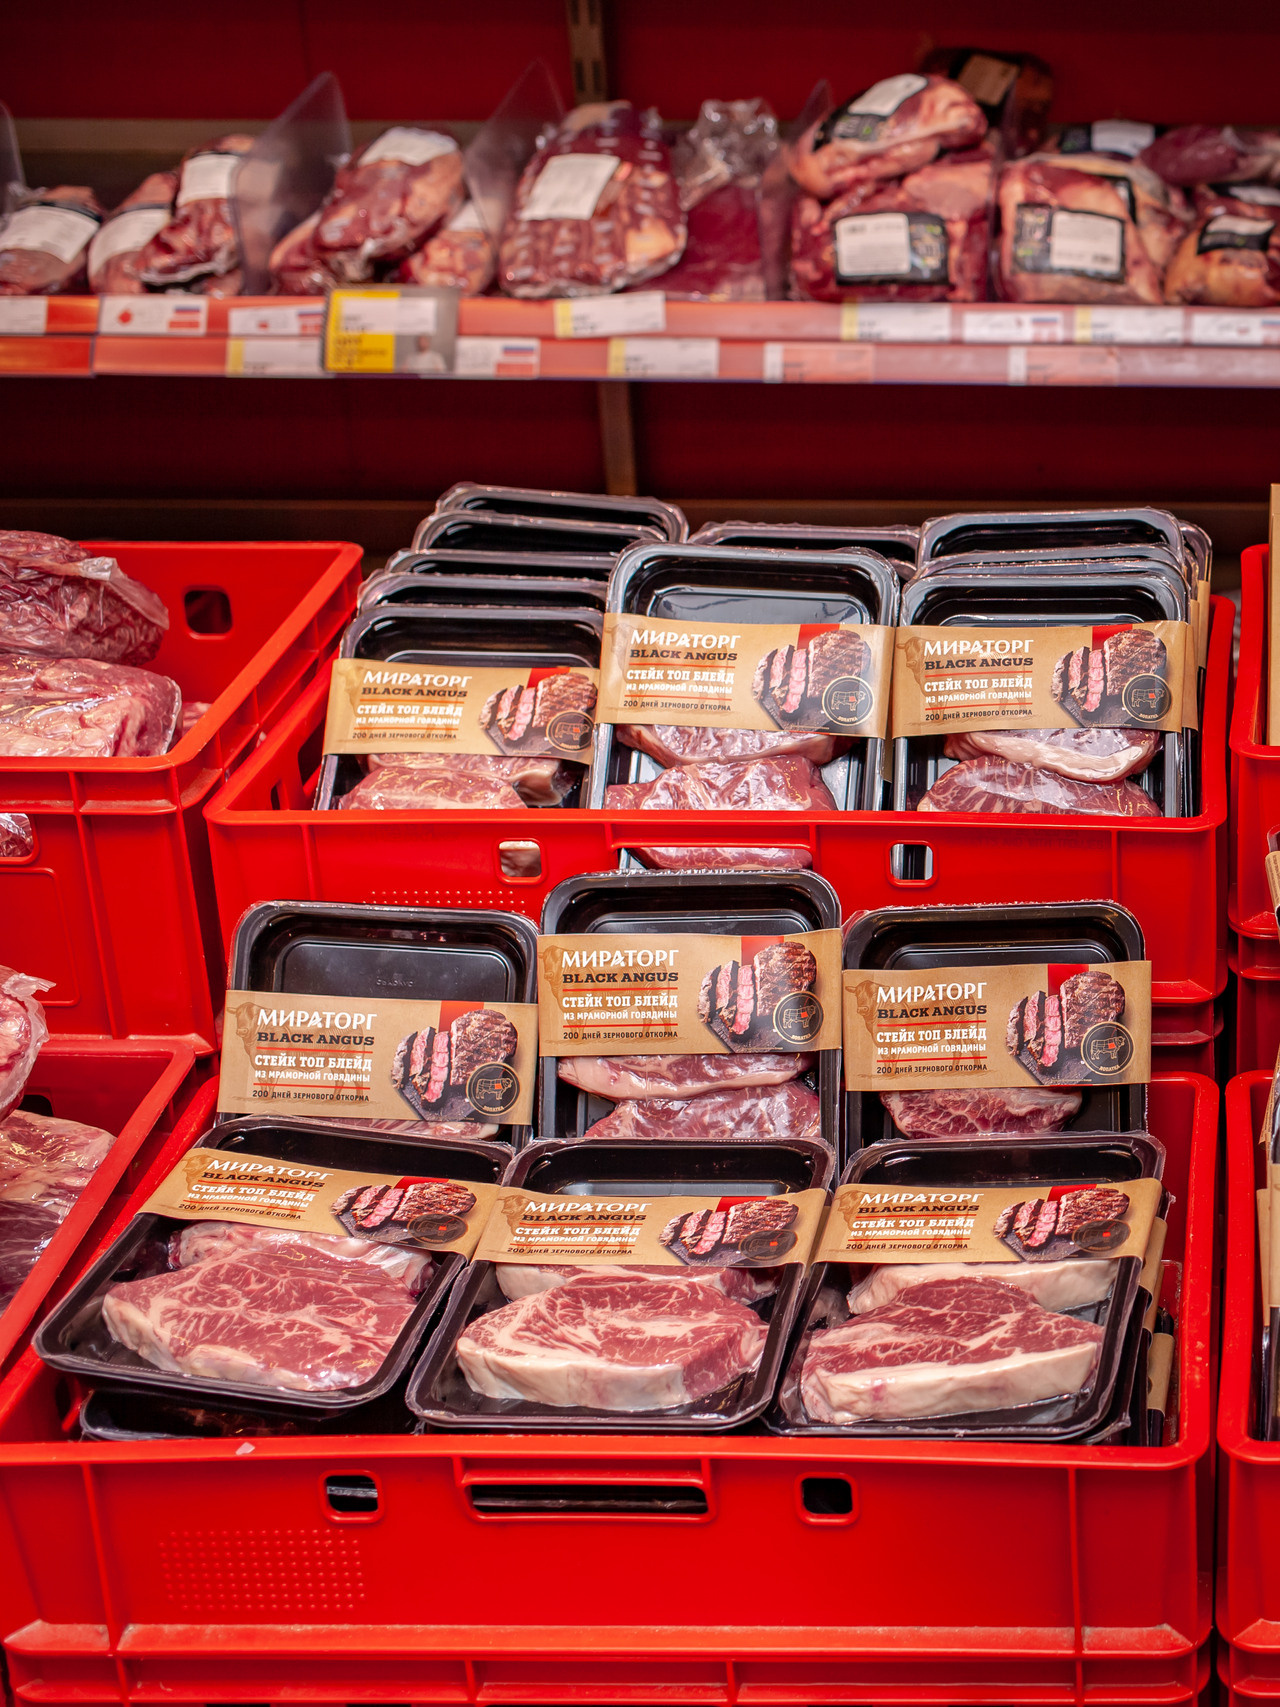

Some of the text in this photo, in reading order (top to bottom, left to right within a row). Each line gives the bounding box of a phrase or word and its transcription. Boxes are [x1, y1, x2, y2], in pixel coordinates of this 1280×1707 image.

[630, 629, 741, 649] МИРАТОРГ
[924, 639, 1034, 656] МИРАТОРГ
[630, 649, 738, 660] BLACK ANGUS
[925, 657, 1033, 670] BLACK ANGUS
[363, 671, 472, 688] МИРАТОРГ
[626, 667, 734, 684] СТЕЙК ТОП БЛЕЙД
[924, 675, 1032, 692] СТЕЙК ТОП БЛЕЙД
[942, 712, 960, 720] ДНЕЙ
[962, 710, 1000, 719] ЗЕРНОВОГО
[562, 950, 678, 968] МИРАТОРГ
[563, 972, 678, 984] BLACK ANGUS
[876, 982, 987, 1003] МИРАТОРГ
[563, 993, 678, 1008] СТЕЙК ТОП БЛЕЙД
[564, 1009, 677, 1020] ИЗ МРАМОРНОЙ ГОВЯДИНЫ
[877, 1004, 987, 1018] BLACK ANGUS
[257, 1008, 377, 1030] МИРАТОРГ
[257, 1032, 375, 1046] BLACK ANGUS
[582, 1030, 600, 1040] ДНЕЙ
[646, 1030, 678, 1038] ОТКОРМА
[877, 1026, 987, 1043] СТЕЙК ТОП БЛЕЙД
[878, 1043, 986, 1055] ИЗ МРАМОРНОЙ ГОВЯДИНЫ
[255, 1053, 372, 1071] СТЕЙК ТОП БЛЕЙД
[255, 1069, 370, 1082] ИЗ МРАМОРНОЙ ГОВЯДИНЫ
[877, 1065, 892, 1074] 200
[894, 1064, 912, 1074] ДНЕЙ
[915, 1065, 953, 1073] ЗЕРНОВОГО
[252, 1090, 268, 1098] 200
[271, 1090, 291, 1100] ДНЕЙ
[293, 1092, 334, 1100] ЗЕРНОВОГО
[206, 1159, 335, 1181] МИРАТОРГ
[201, 1171, 325, 1188] BLACK ANGUS
[191, 1184, 316, 1202] СТЕЙК ТОП БЛЕЙД
[860, 1192, 984, 1205] МИРАТОРГ
[525, 1201, 652, 1213] МИРАТОРГ
[858, 1204, 979, 1214] BLACK ANGUS
[522, 1213, 647, 1222] BLACK ANGUS
[853, 1217, 975, 1229] СТЕЙК ТОП БЛЕЙД
[515, 1226, 641, 1236] СТЕЙК ТОП БЛЕЙД
